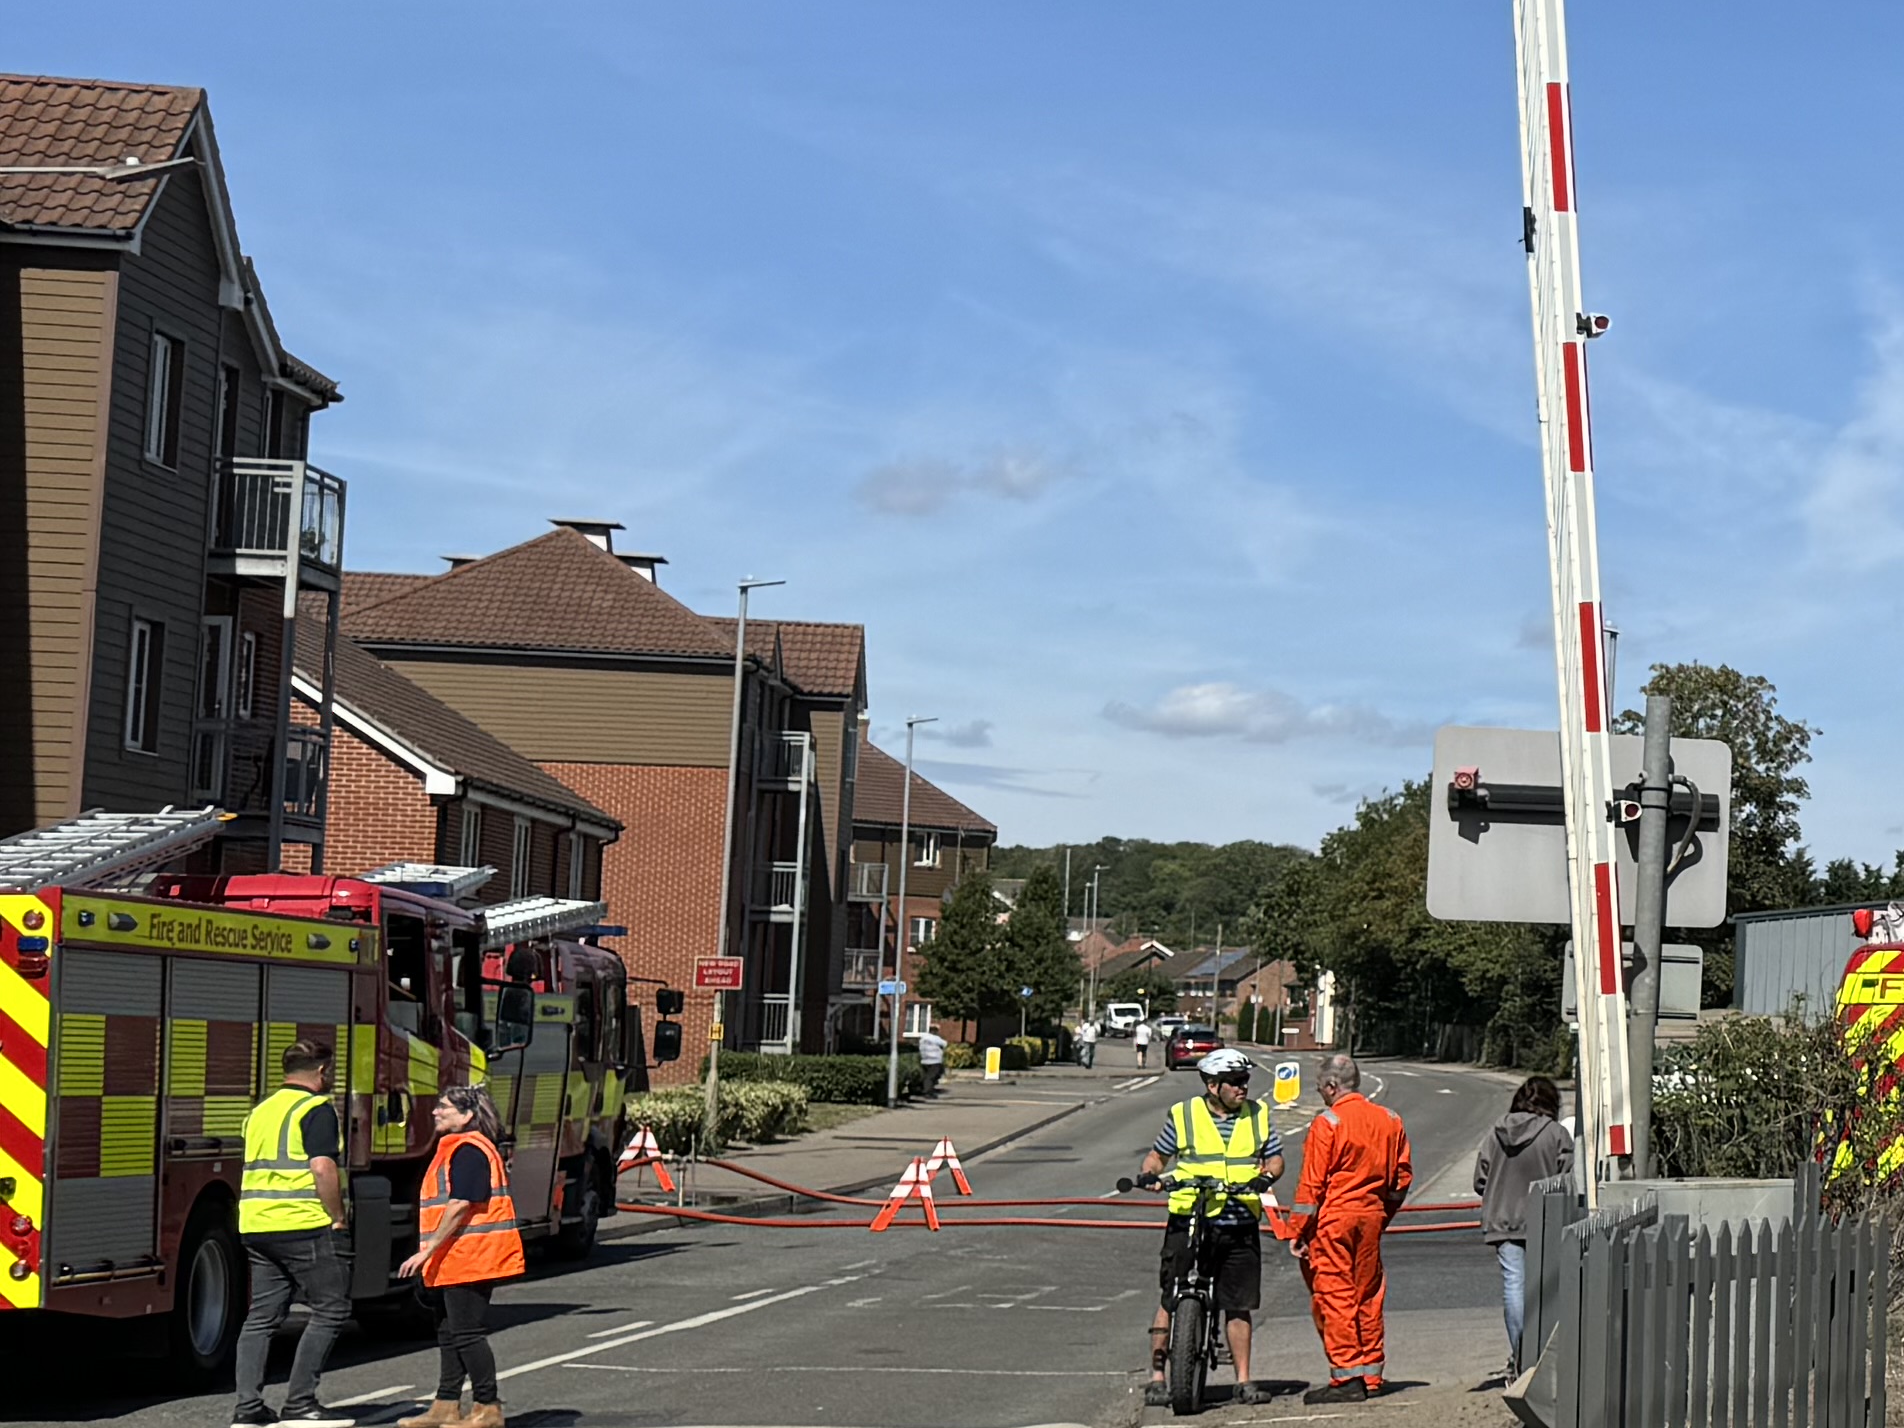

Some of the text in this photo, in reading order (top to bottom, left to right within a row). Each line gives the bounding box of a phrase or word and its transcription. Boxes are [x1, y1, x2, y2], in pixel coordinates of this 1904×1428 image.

[149, 913, 293, 955] Fire and Rescue Service
